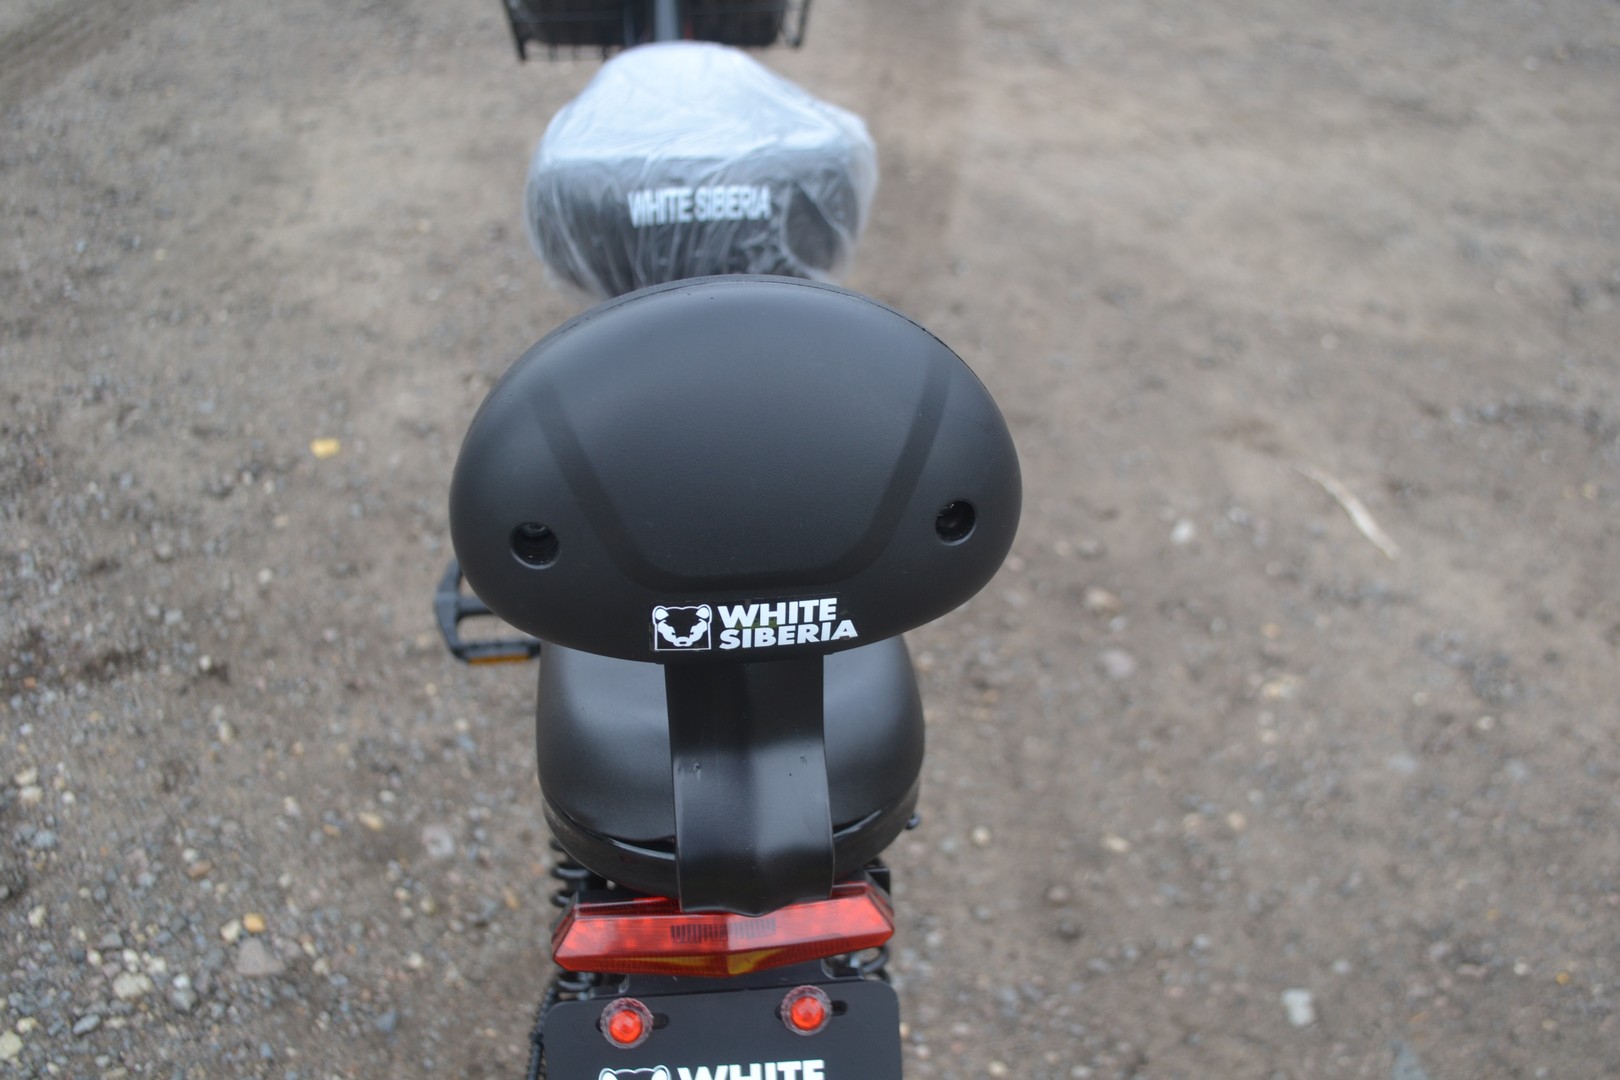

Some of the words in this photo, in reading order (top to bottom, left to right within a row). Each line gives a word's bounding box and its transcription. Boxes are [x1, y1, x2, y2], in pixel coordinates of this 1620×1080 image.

[628, 188, 692, 227] WHITE
[695, 185, 771, 221] SIBERIA
[717, 598, 838, 628] WHITE
[719, 620, 858, 650] SIBERIA
